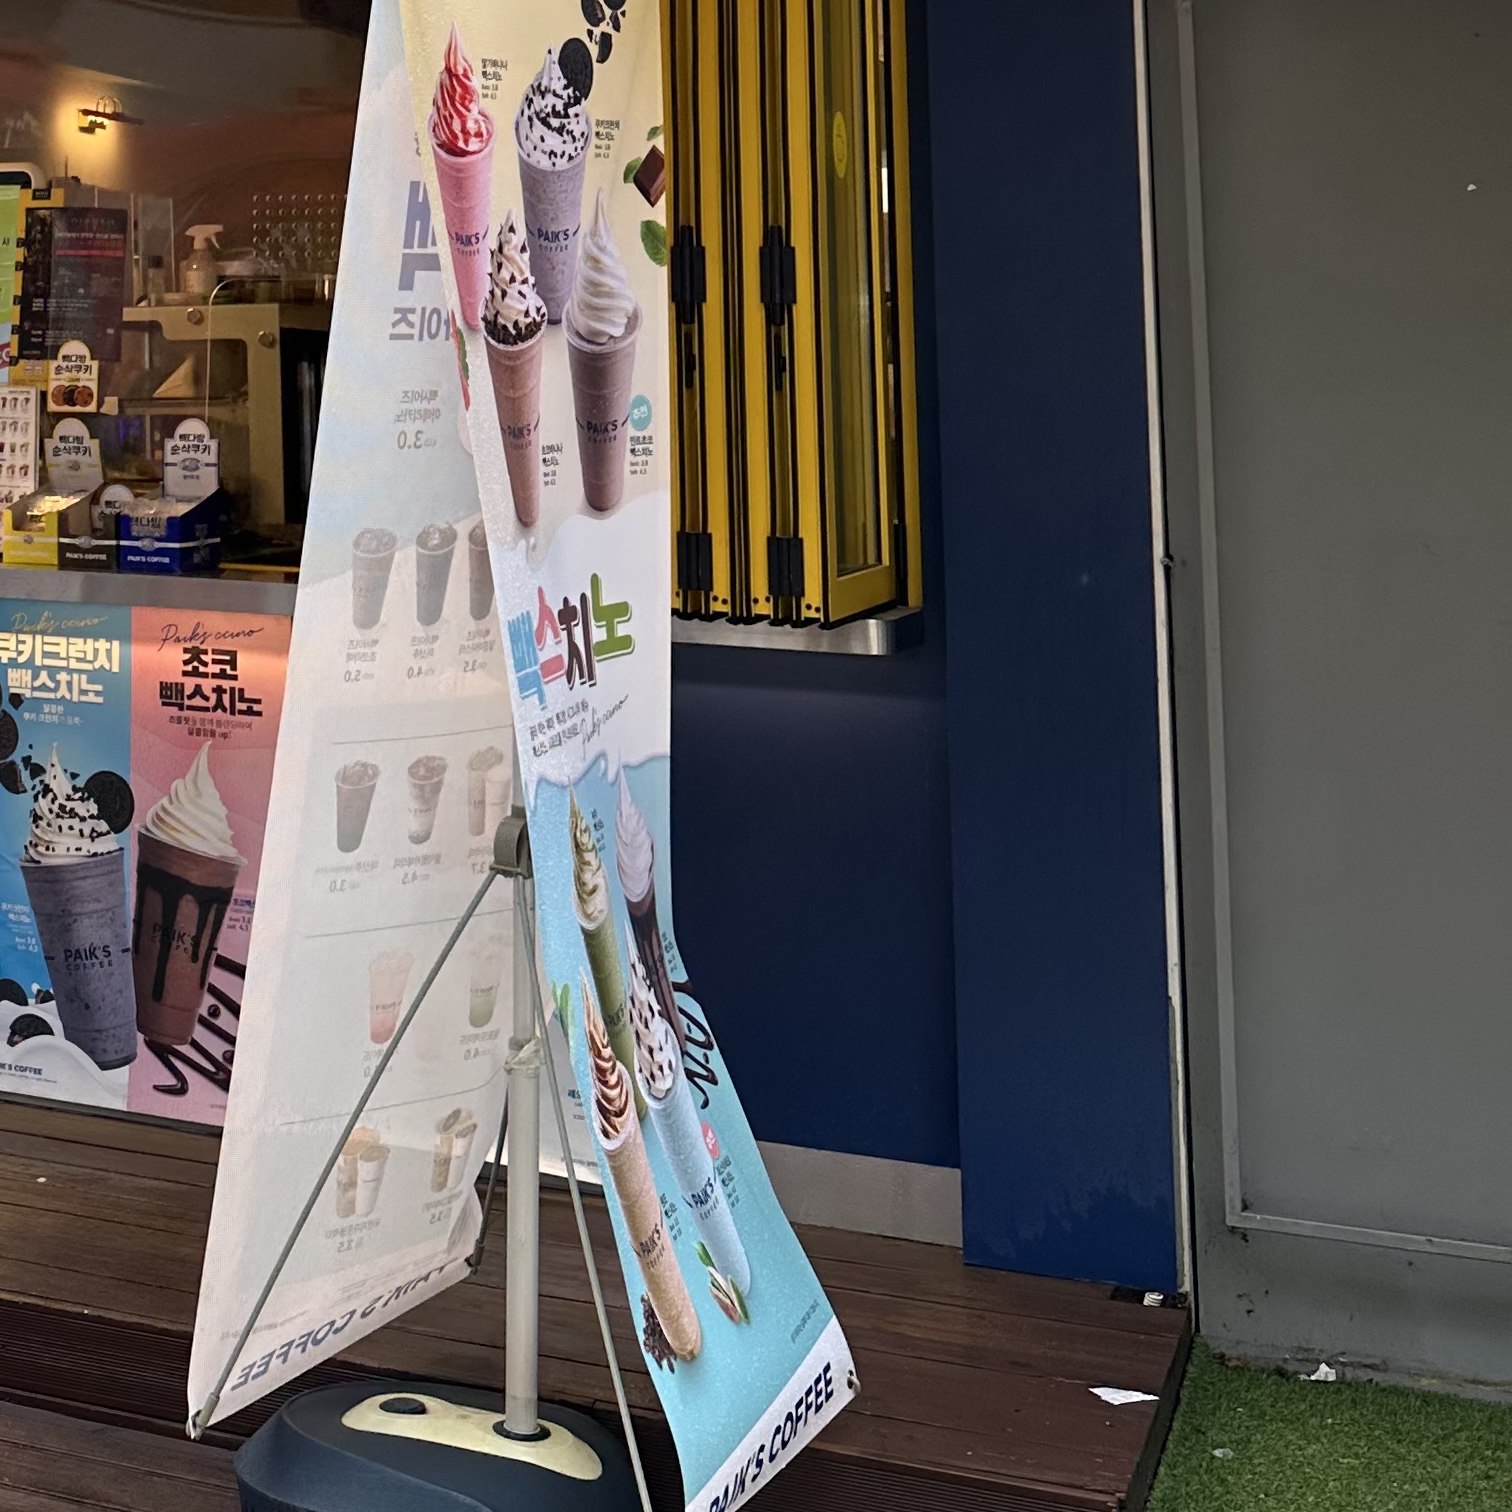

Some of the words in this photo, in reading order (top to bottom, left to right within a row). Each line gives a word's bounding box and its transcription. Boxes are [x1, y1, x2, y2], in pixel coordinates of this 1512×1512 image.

[455, 232, 480, 246] PAIK'S
[538, 228, 570, 243] PAIK'S
[54, 364, 93, 376] 순삭쿠키
[507, 424, 531, 438] PAIK'S
[588, 420, 618, 435] PAIK'S
[52, 445, 92, 457] 순삭쿠키
[170, 444, 211, 456] 순삭쿠키
[507, 573, 636, 711] 빽스치노
[182, 646, 238, 682] 초코
[7, 667, 104, 704] 빽스치노
[159, 681, 263, 718] 빽스치노
[64, 944, 112, 963] PAIK'S
[66, 959, 113, 973] COFFEE
[14, 1064, 43, 1076] COFFEE
[692, 1176, 714, 1208] PAIK'S
[640, 1223, 662, 1259] PAIK'S
[769, 1361, 834, 1464] COFFEE
